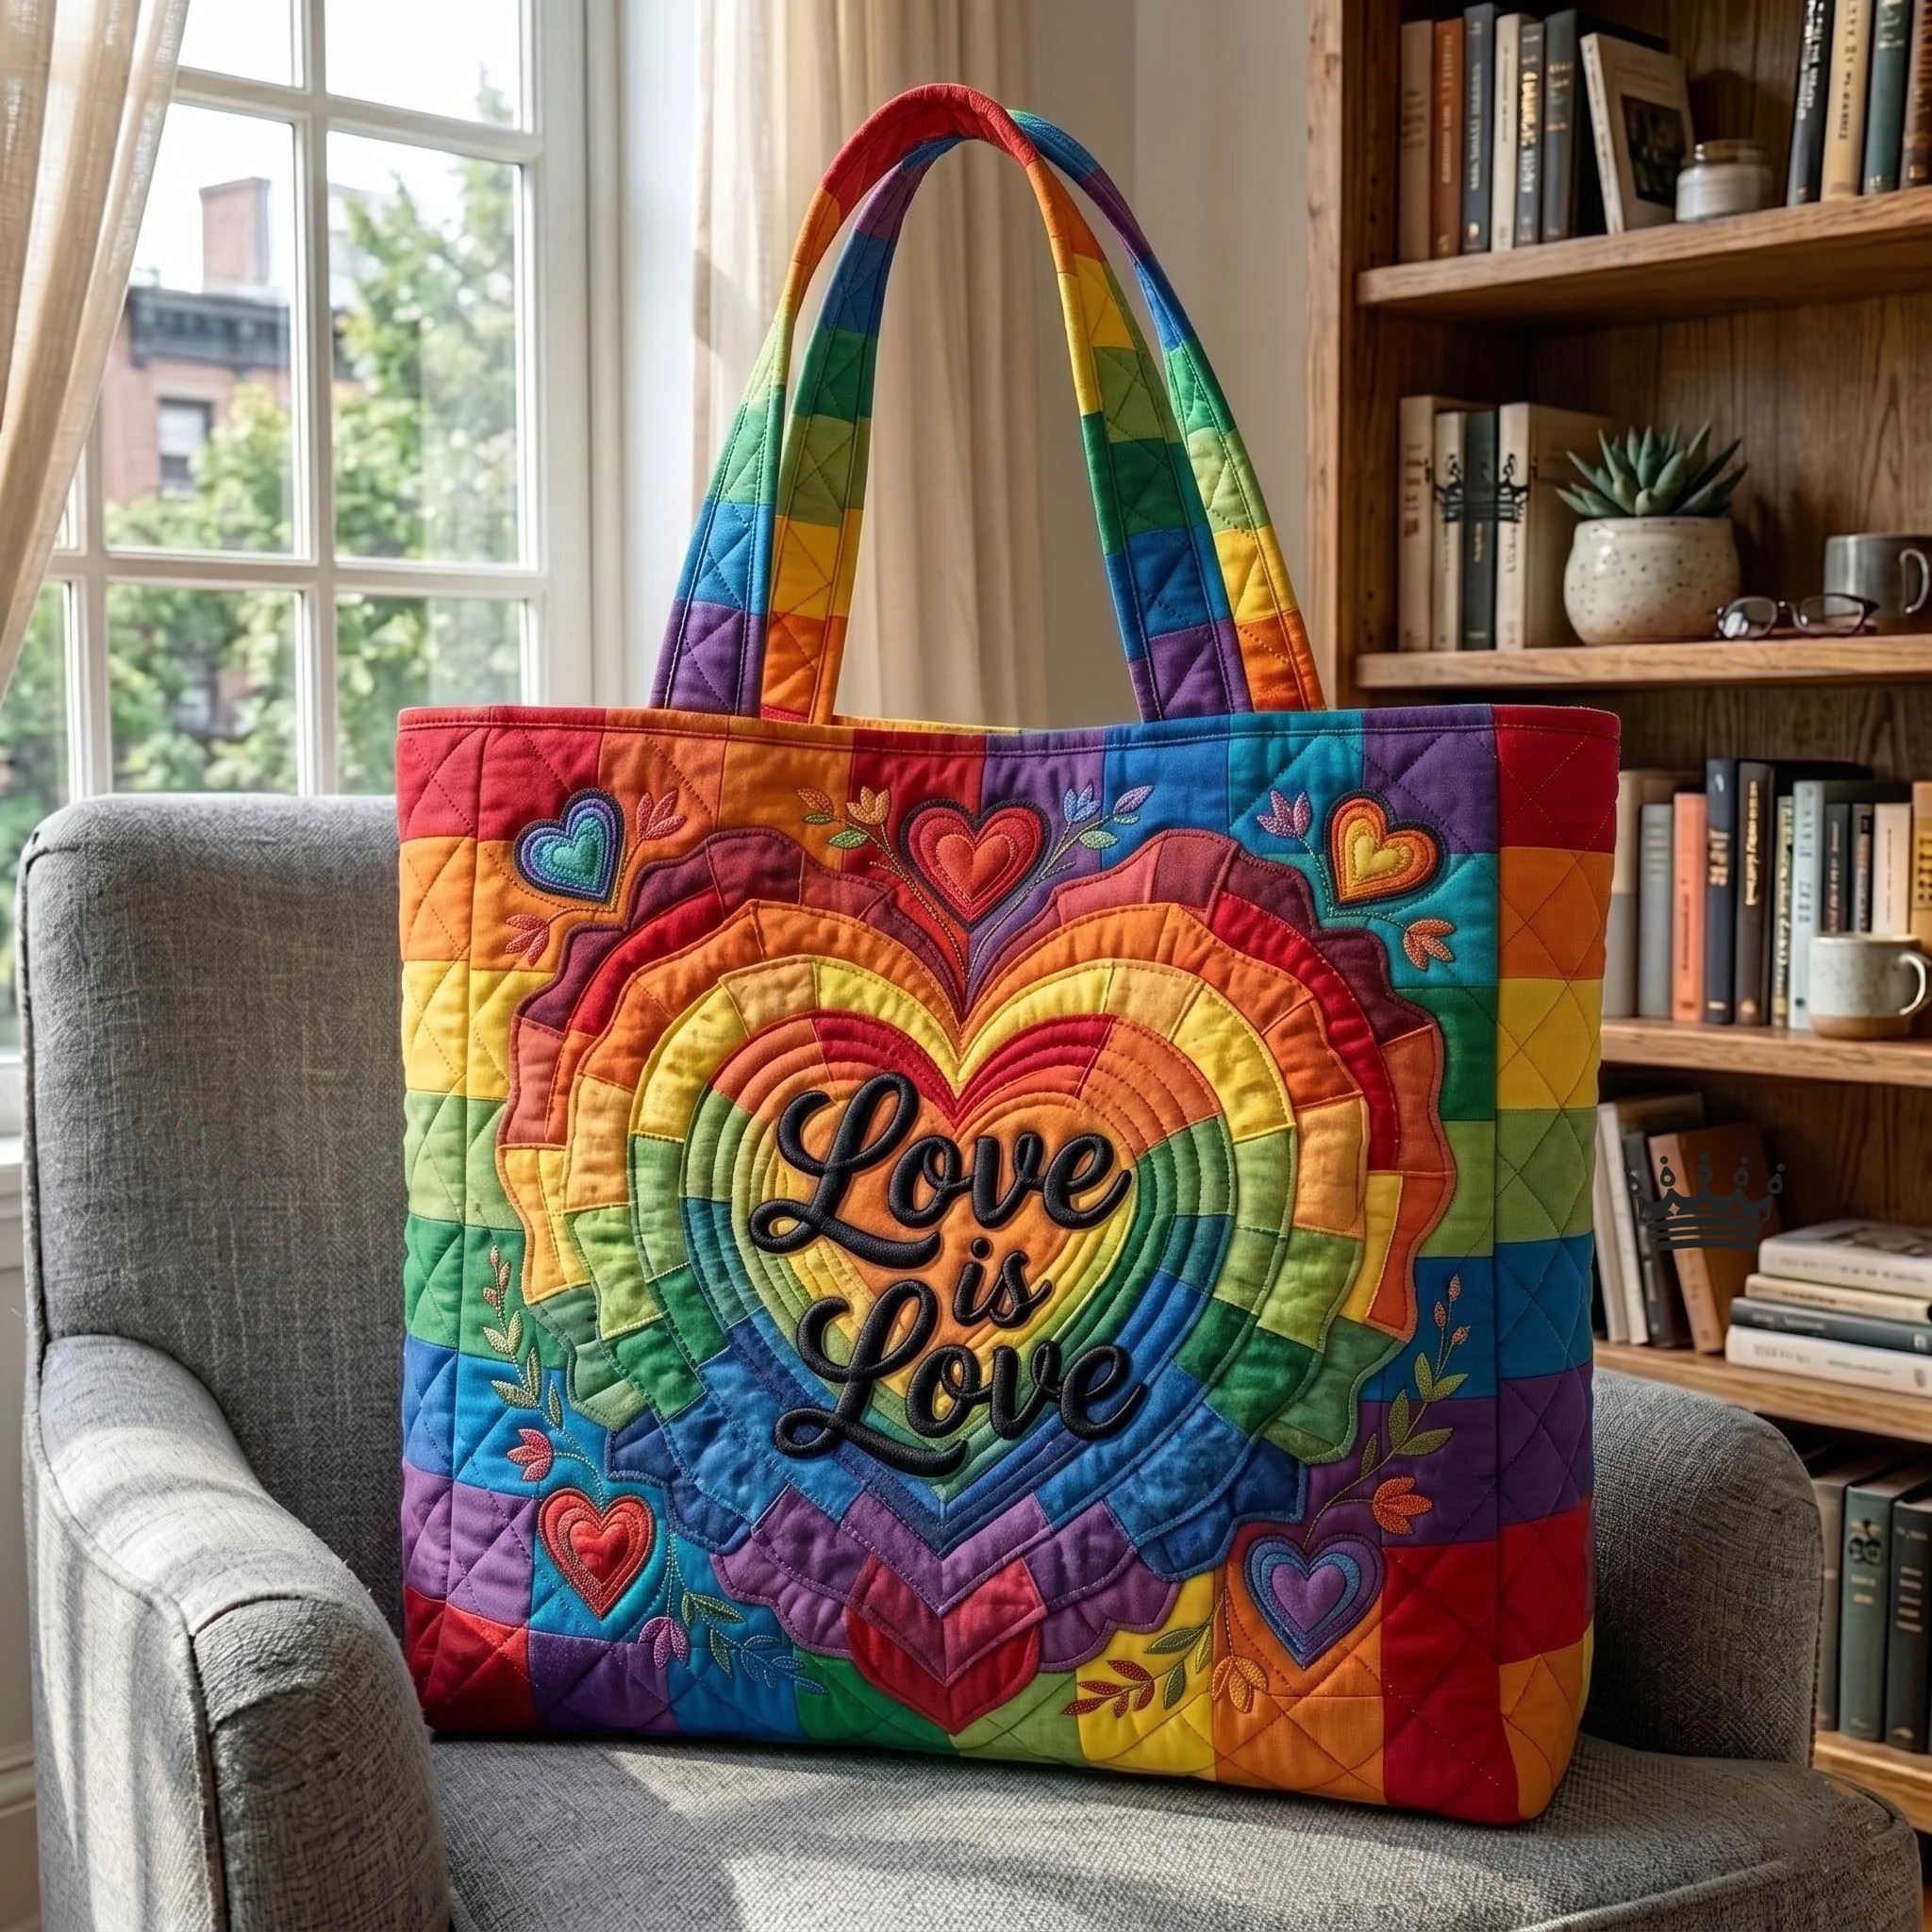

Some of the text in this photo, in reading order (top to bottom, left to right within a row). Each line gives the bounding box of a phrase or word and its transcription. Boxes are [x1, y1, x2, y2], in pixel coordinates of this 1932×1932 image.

[750, 1072, 1131, 1268] Love
[775, 1280, 1145, 1476] Love
[954, 1238, 1052, 1328] is
